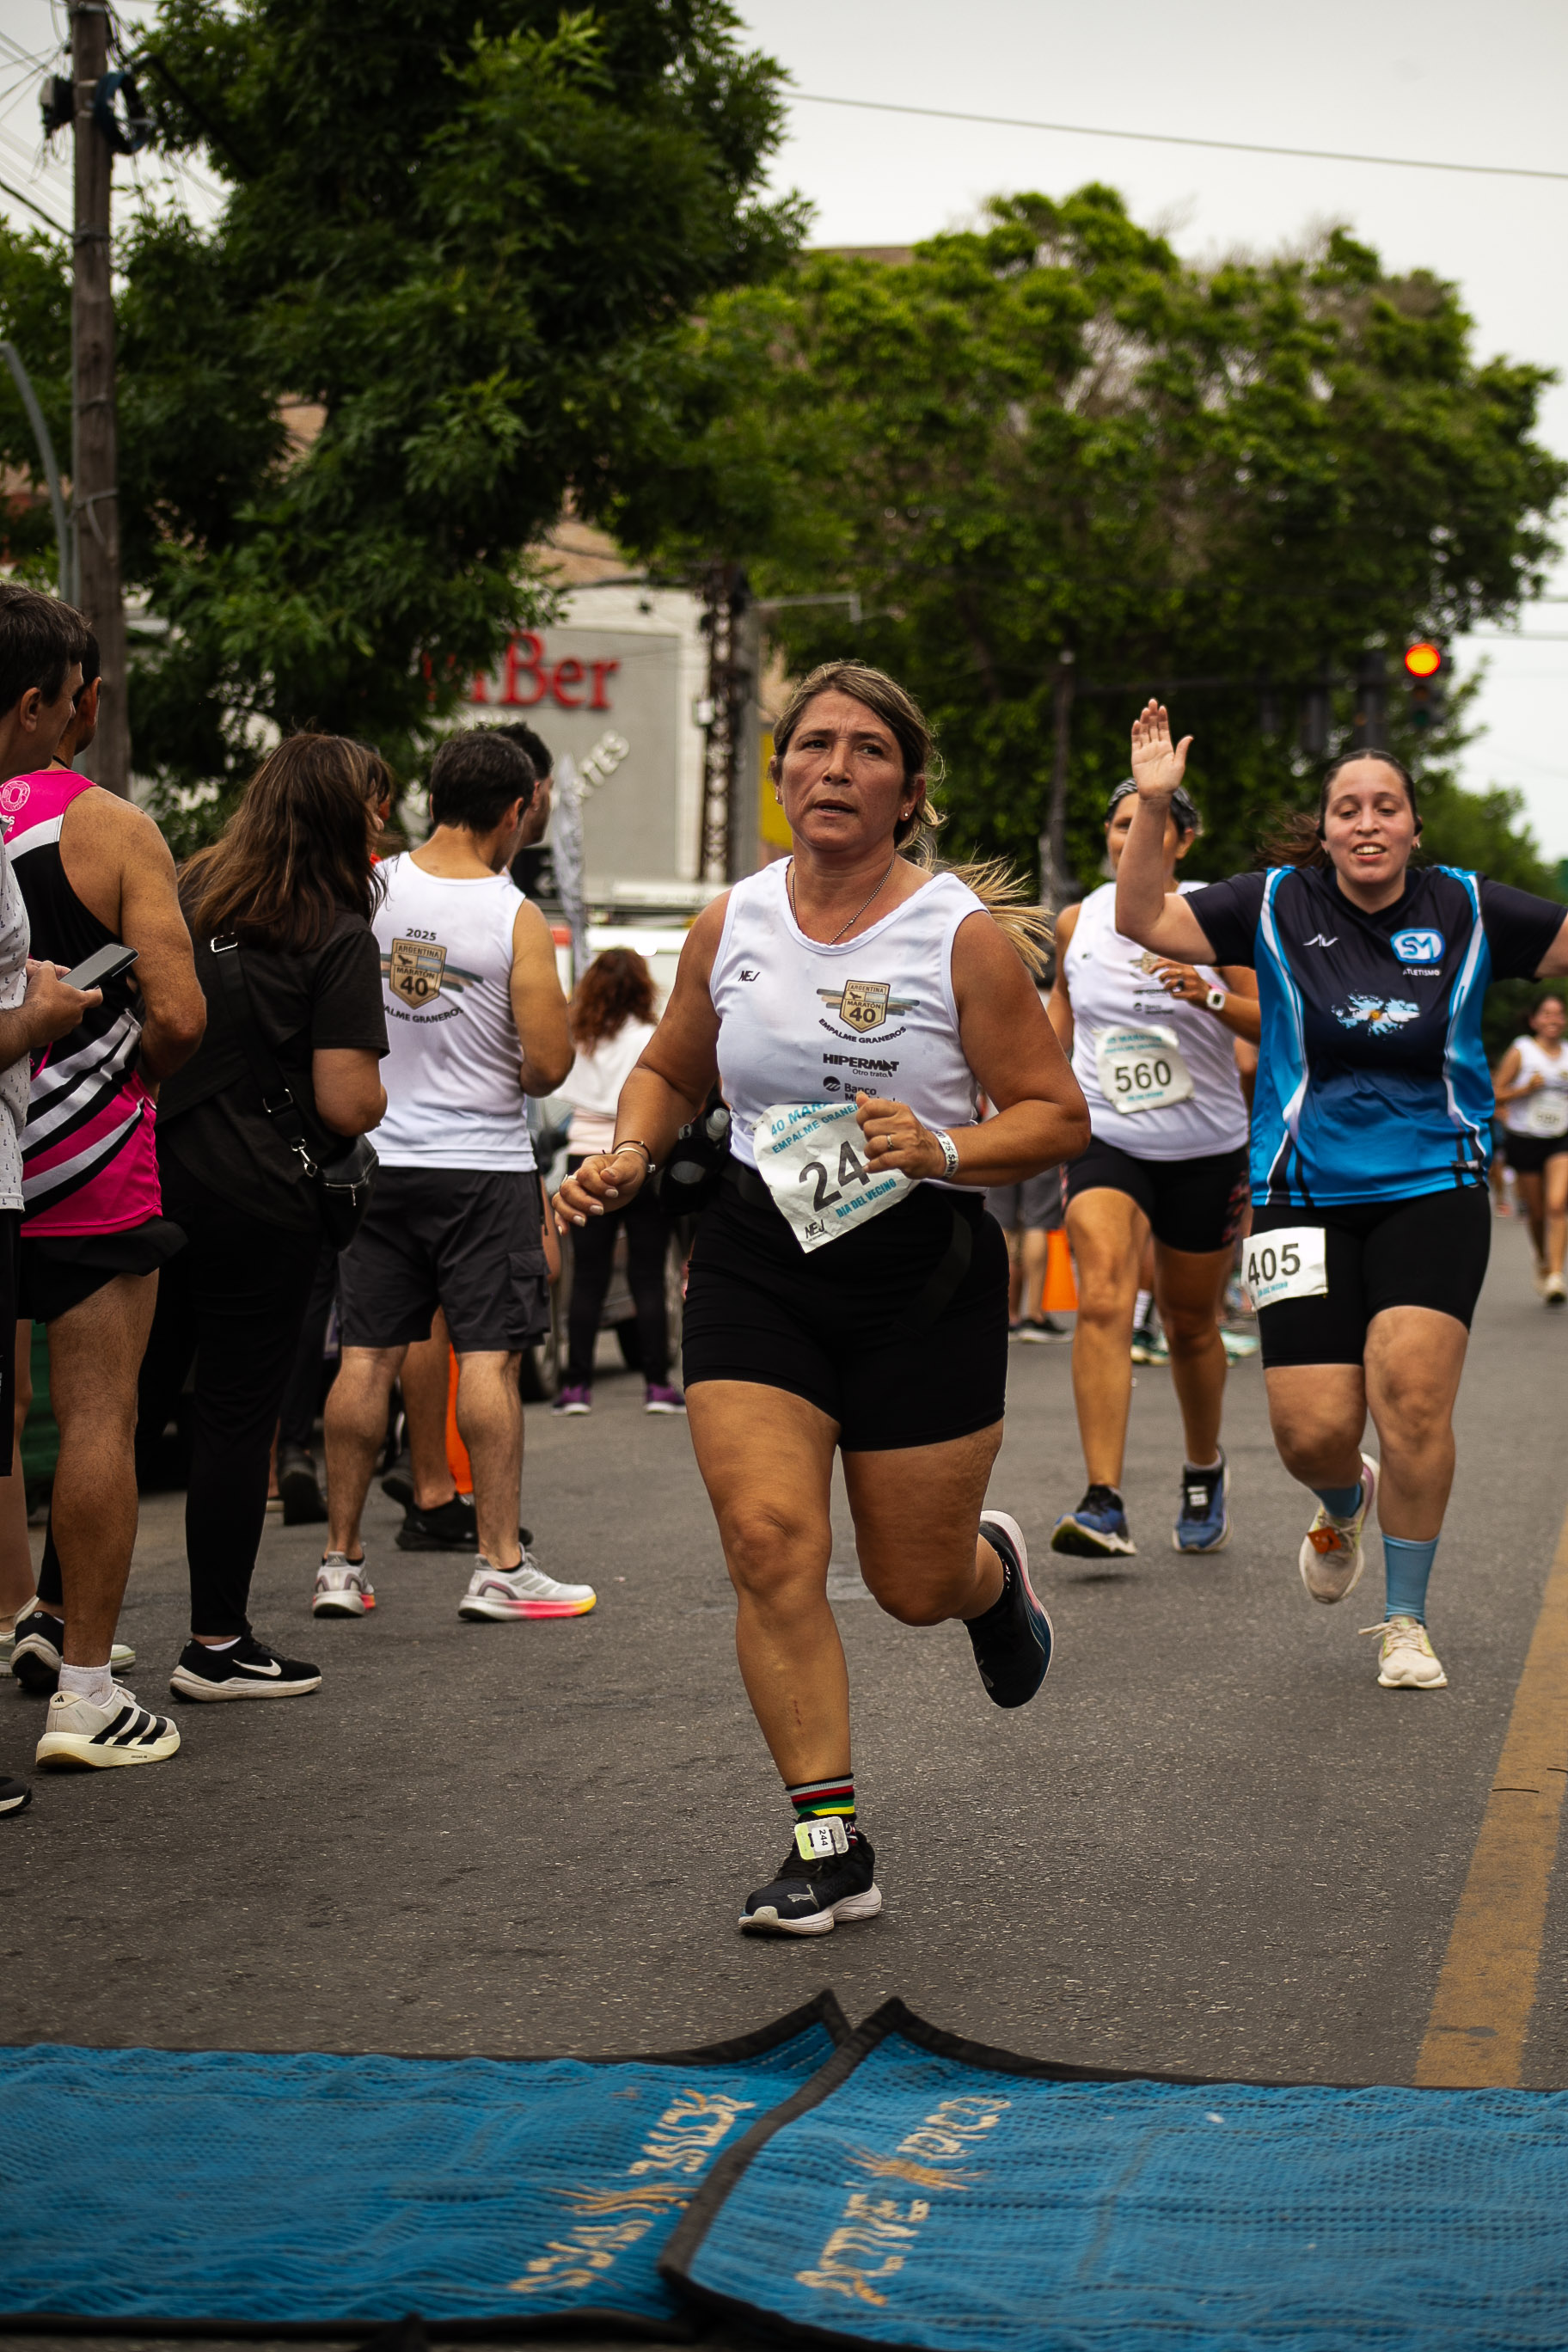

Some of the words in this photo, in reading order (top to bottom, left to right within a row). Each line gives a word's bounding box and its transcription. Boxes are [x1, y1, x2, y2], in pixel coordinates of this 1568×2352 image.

[406, 928, 437, 941] 2025
[398, 945, 439, 959] ARGENTINA
[1403, 968, 1441, 977] ATLETISMO
[400, 976, 429, 997] 40
[849, 984, 884, 994] ARGENTINA
[383, 1005, 410, 1022] ALME
[849, 1007, 876, 1023] 40
[818, 1018, 857, 1043] EMPALME
[858, 1026, 907, 1044] GRANEROS
[1114, 1060, 1172, 1093] 560
[771, 1119, 786, 1136] 40
[772, 1120, 820, 1154] EMPALME
[799, 1140, 871, 1213] 24
[836, 1204, 853, 1218] DIA
[850, 1196, 867, 1210] DEL
[865, 1178, 897, 1201] VECINO
[1247, 1243, 1301, 1286] 405
[818, 1828, 829, 1847] 244
